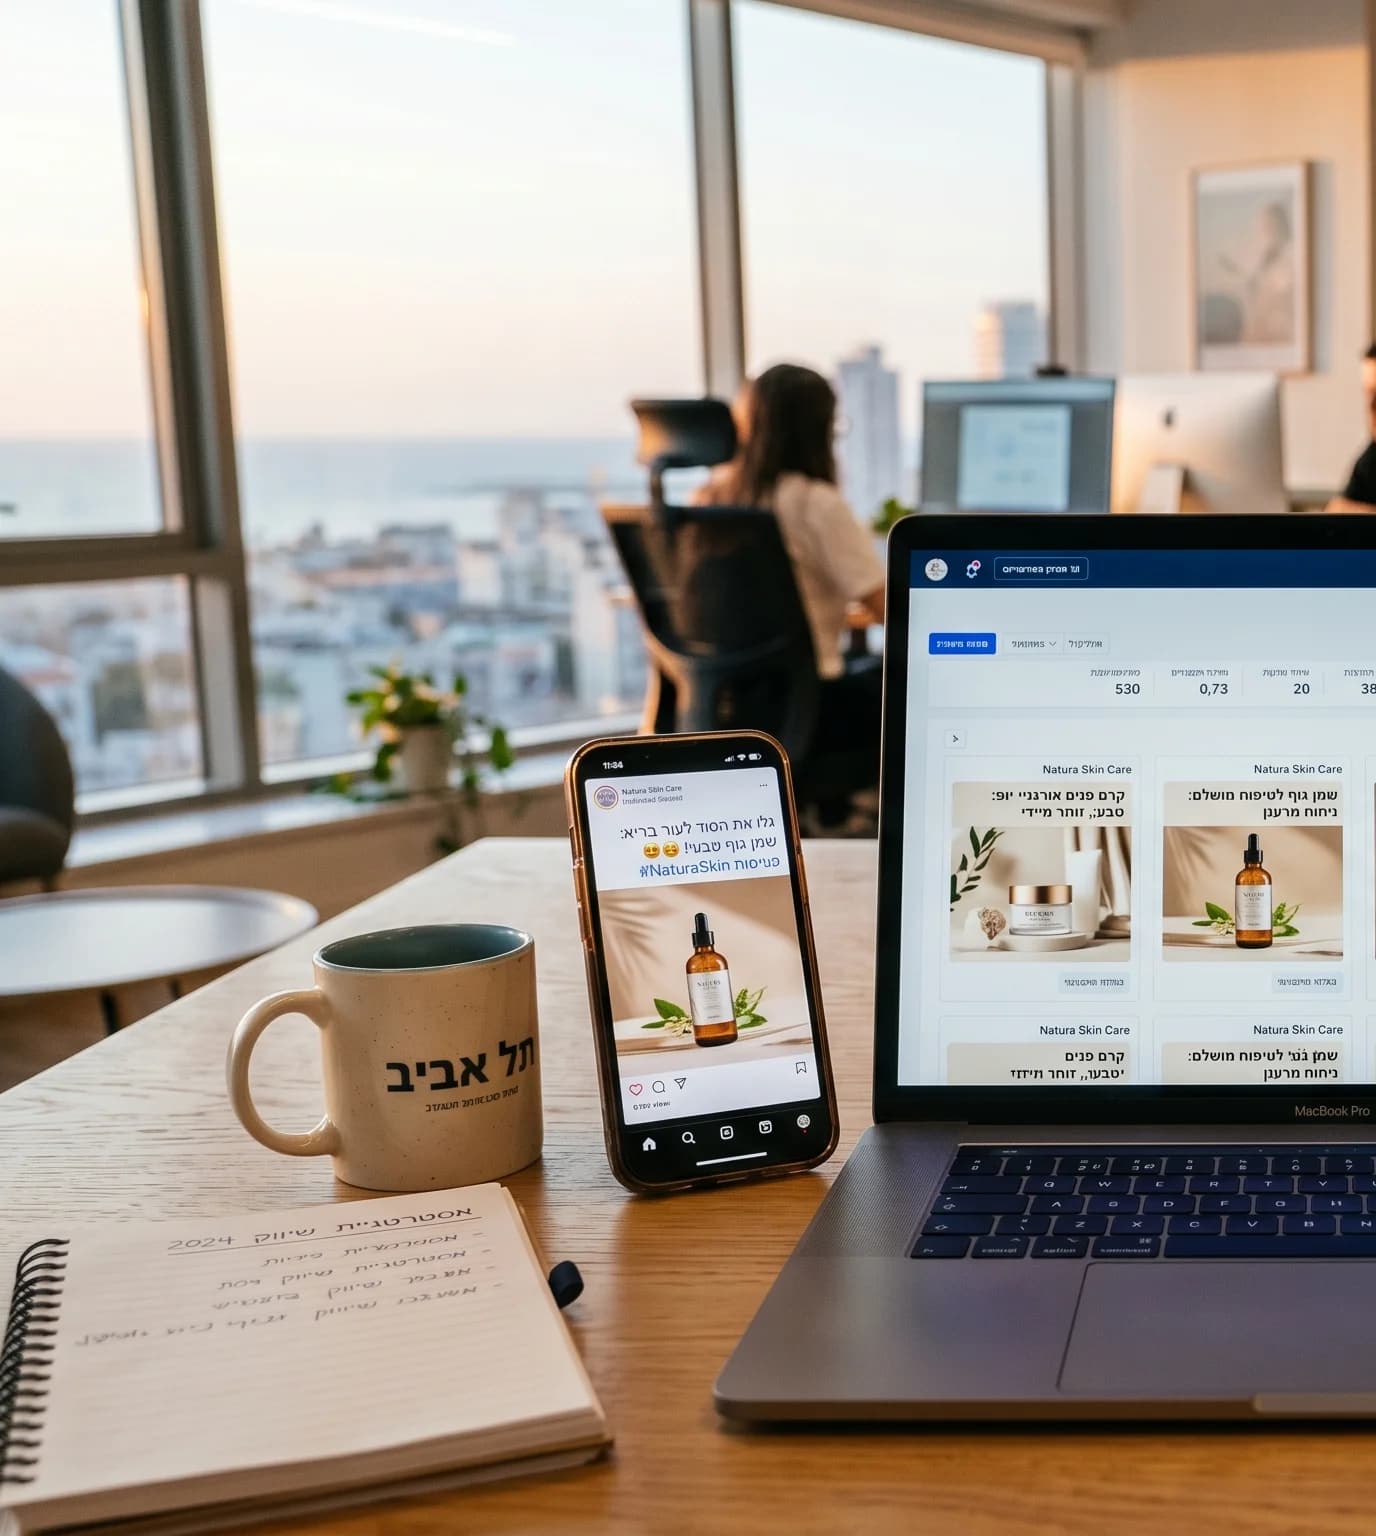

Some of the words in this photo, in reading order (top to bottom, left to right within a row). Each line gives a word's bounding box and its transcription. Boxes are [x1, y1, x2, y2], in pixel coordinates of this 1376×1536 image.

[1115, 683, 1141, 695] 530
[1199, 683, 1229, 696] 0,73
[1293, 683, 1310, 695] 20
[1043, 764, 1079, 775] Natura
[1081, 764, 1105, 775] Skin
[1107, 764, 1132, 775] Care
[1254, 764, 1290, 774] Natura
[1292, 764, 1315, 774] Skin
[1317, 764, 1343, 774] Care
[1066, 791, 1094, 801] פנים
[1098, 791, 1125, 804] קרם
[1239, 788, 1284, 801] לטיפוח
[1288, 791, 1308, 803] גוף
[1313, 791, 1338, 803] שמן
[1263, 807, 1300, 820] מרענן
[1304, 807, 1338, 817] ניחוח
[696, 820, 729, 833] הסוד
[733, 819, 753, 831] את
[757, 815, 775, 829] גלו
[725, 840, 747, 853] גוף
[751, 837, 777, 851] שמן
[1040, 1025, 1076, 1035] Natura
[1078, 1025, 1102, 1035] Skin
[1104, 1025, 1131, 1035] Care
[1253, 1024, 1289, 1035] Natura
[1292, 1024, 1315, 1035] Skin
[1318, 1024, 1344, 1035] Care
[499, 1036, 534, 1078] תל
[1065, 1052, 1094, 1062] פנים
[1098, 1052, 1125, 1064] קרם
[386, 1053, 489, 1092] אביב
[1304, 1068, 1338, 1078] ניחוח
[1295, 1105, 1348, 1117] MacBook
[1351, 1105, 1370, 1117] Pro
[336, 1207, 473, 1232] אסטרטגיית
[168, 1235, 236, 1250] 2024
